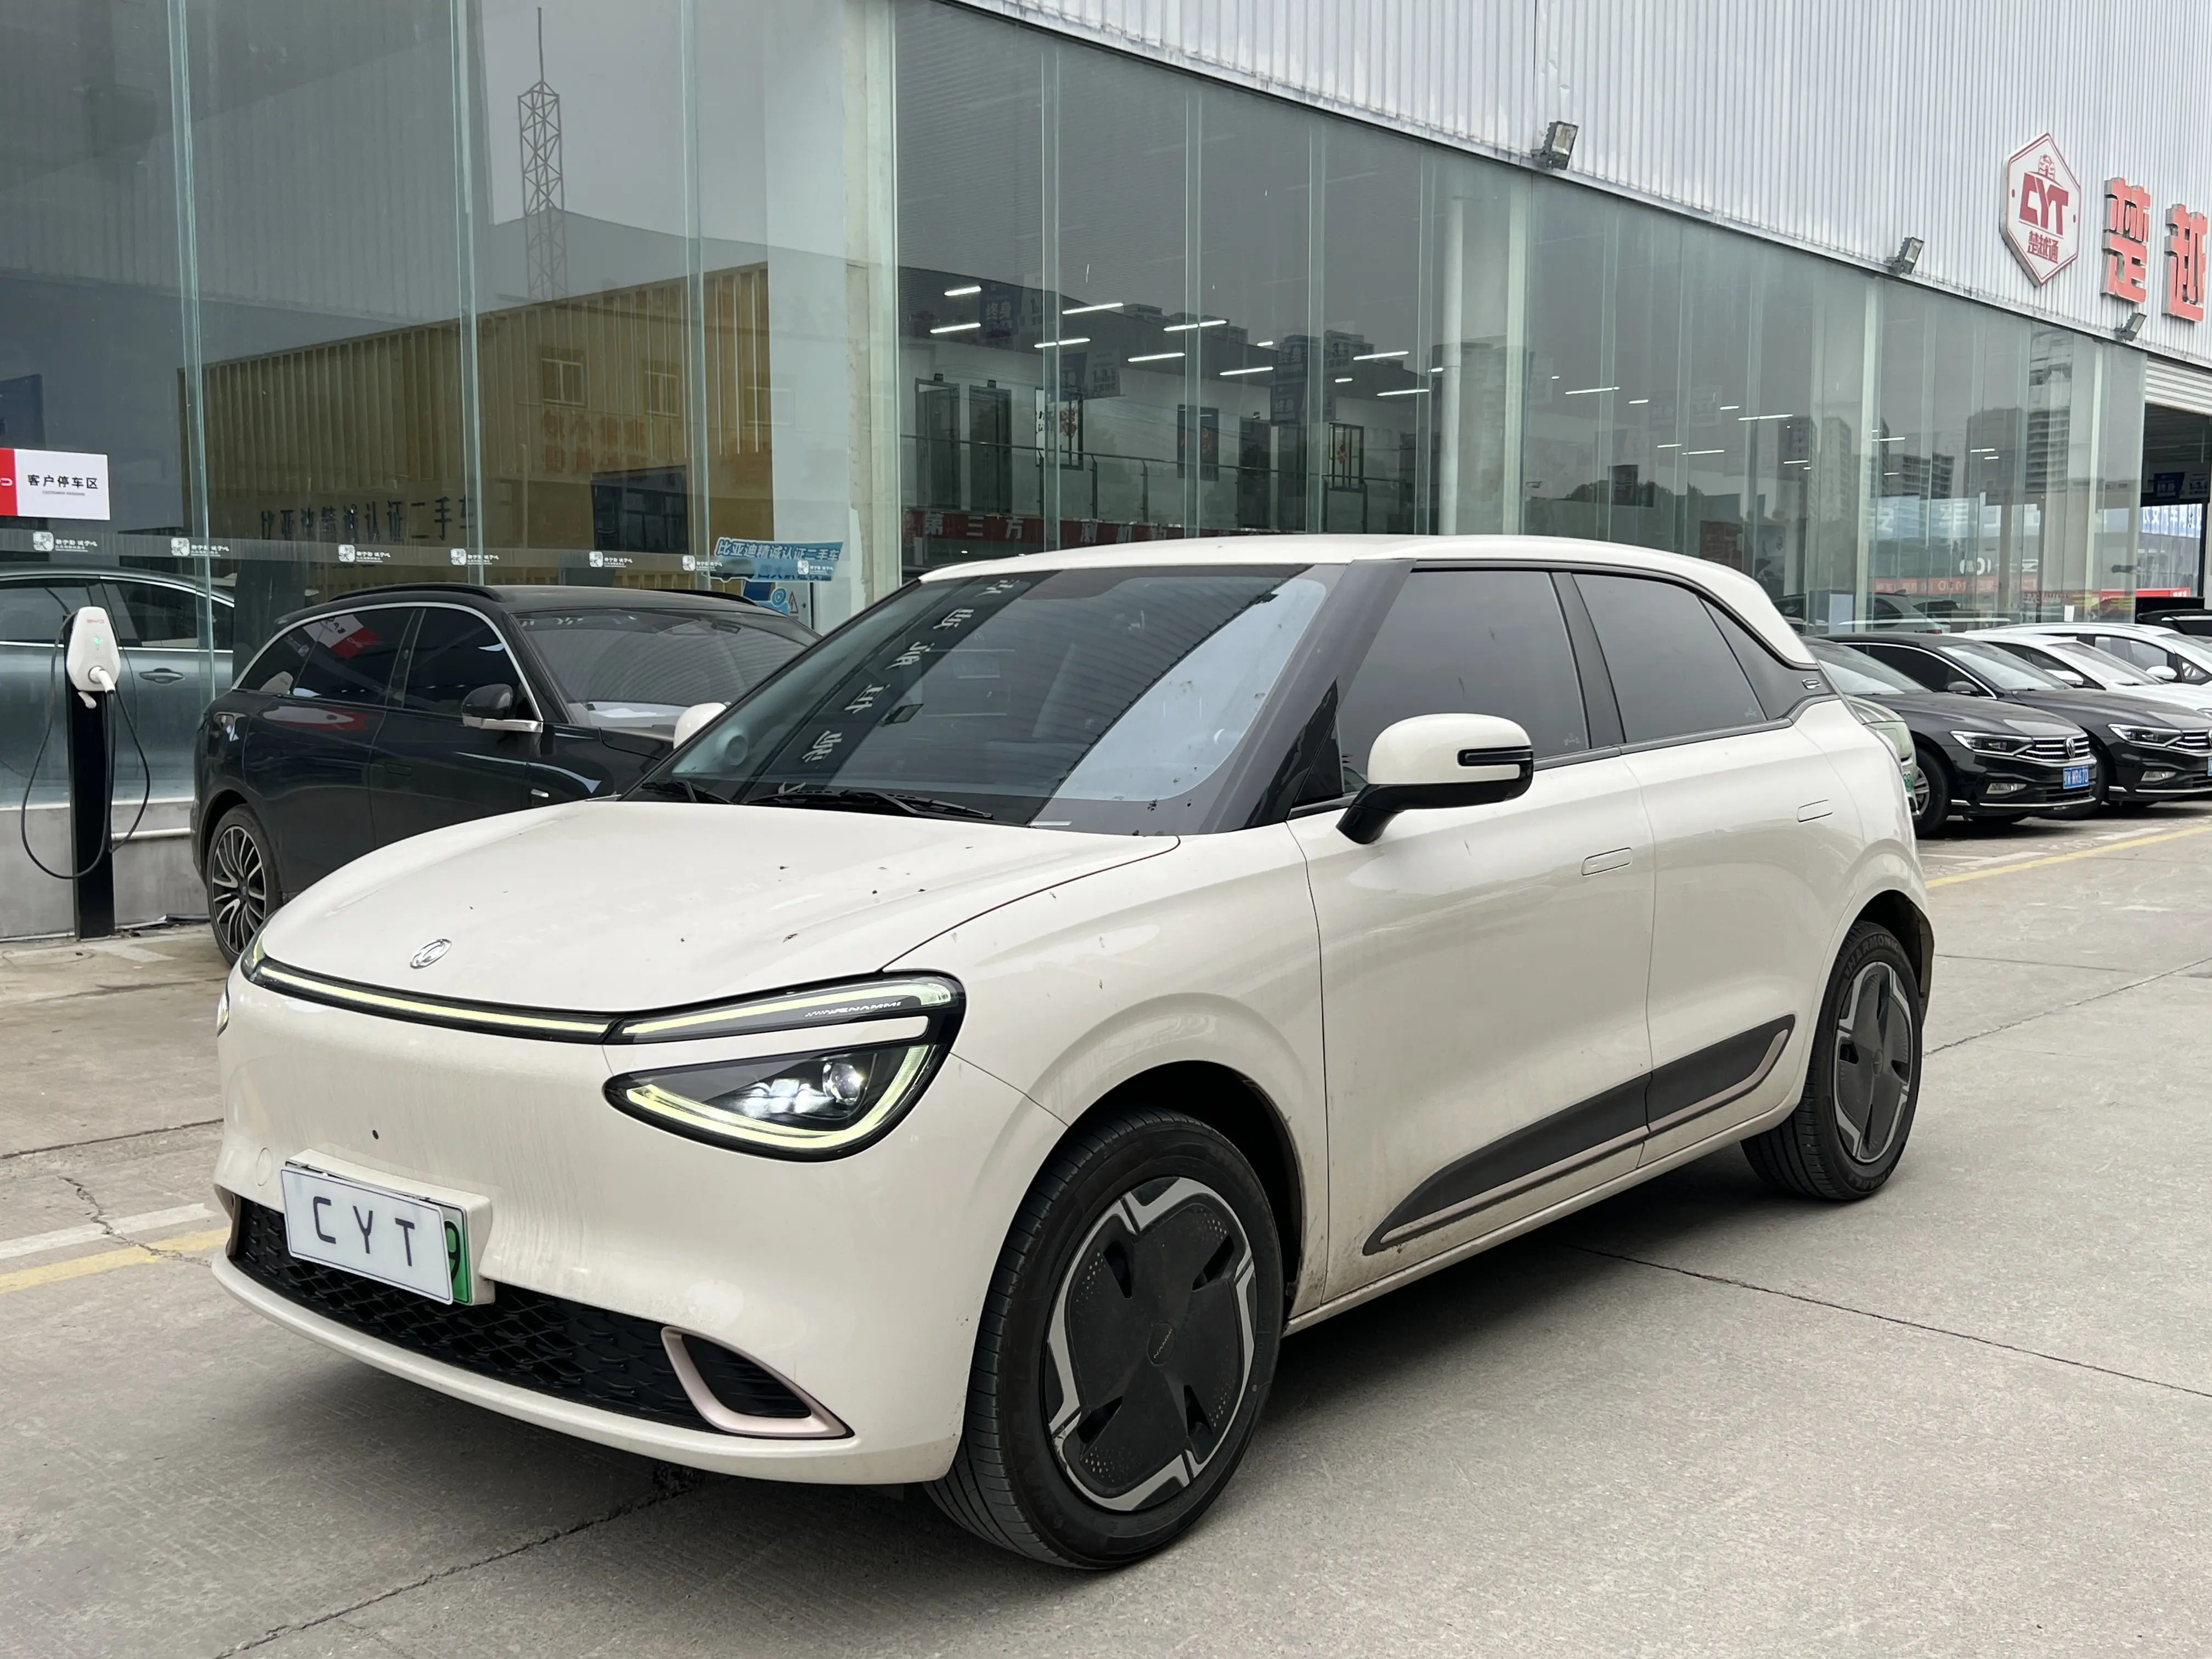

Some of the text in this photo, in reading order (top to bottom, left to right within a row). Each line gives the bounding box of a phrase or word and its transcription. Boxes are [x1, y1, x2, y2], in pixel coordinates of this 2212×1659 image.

[2019, 172, 2069, 235] CYT
[2027, 230, 2059, 263] 楚越通
[27, 474, 98, 489] 客户停车区
[716, 539, 840, 562] 比亚迪精诚认证二手车
[313, 1195, 415, 1267] CYT
